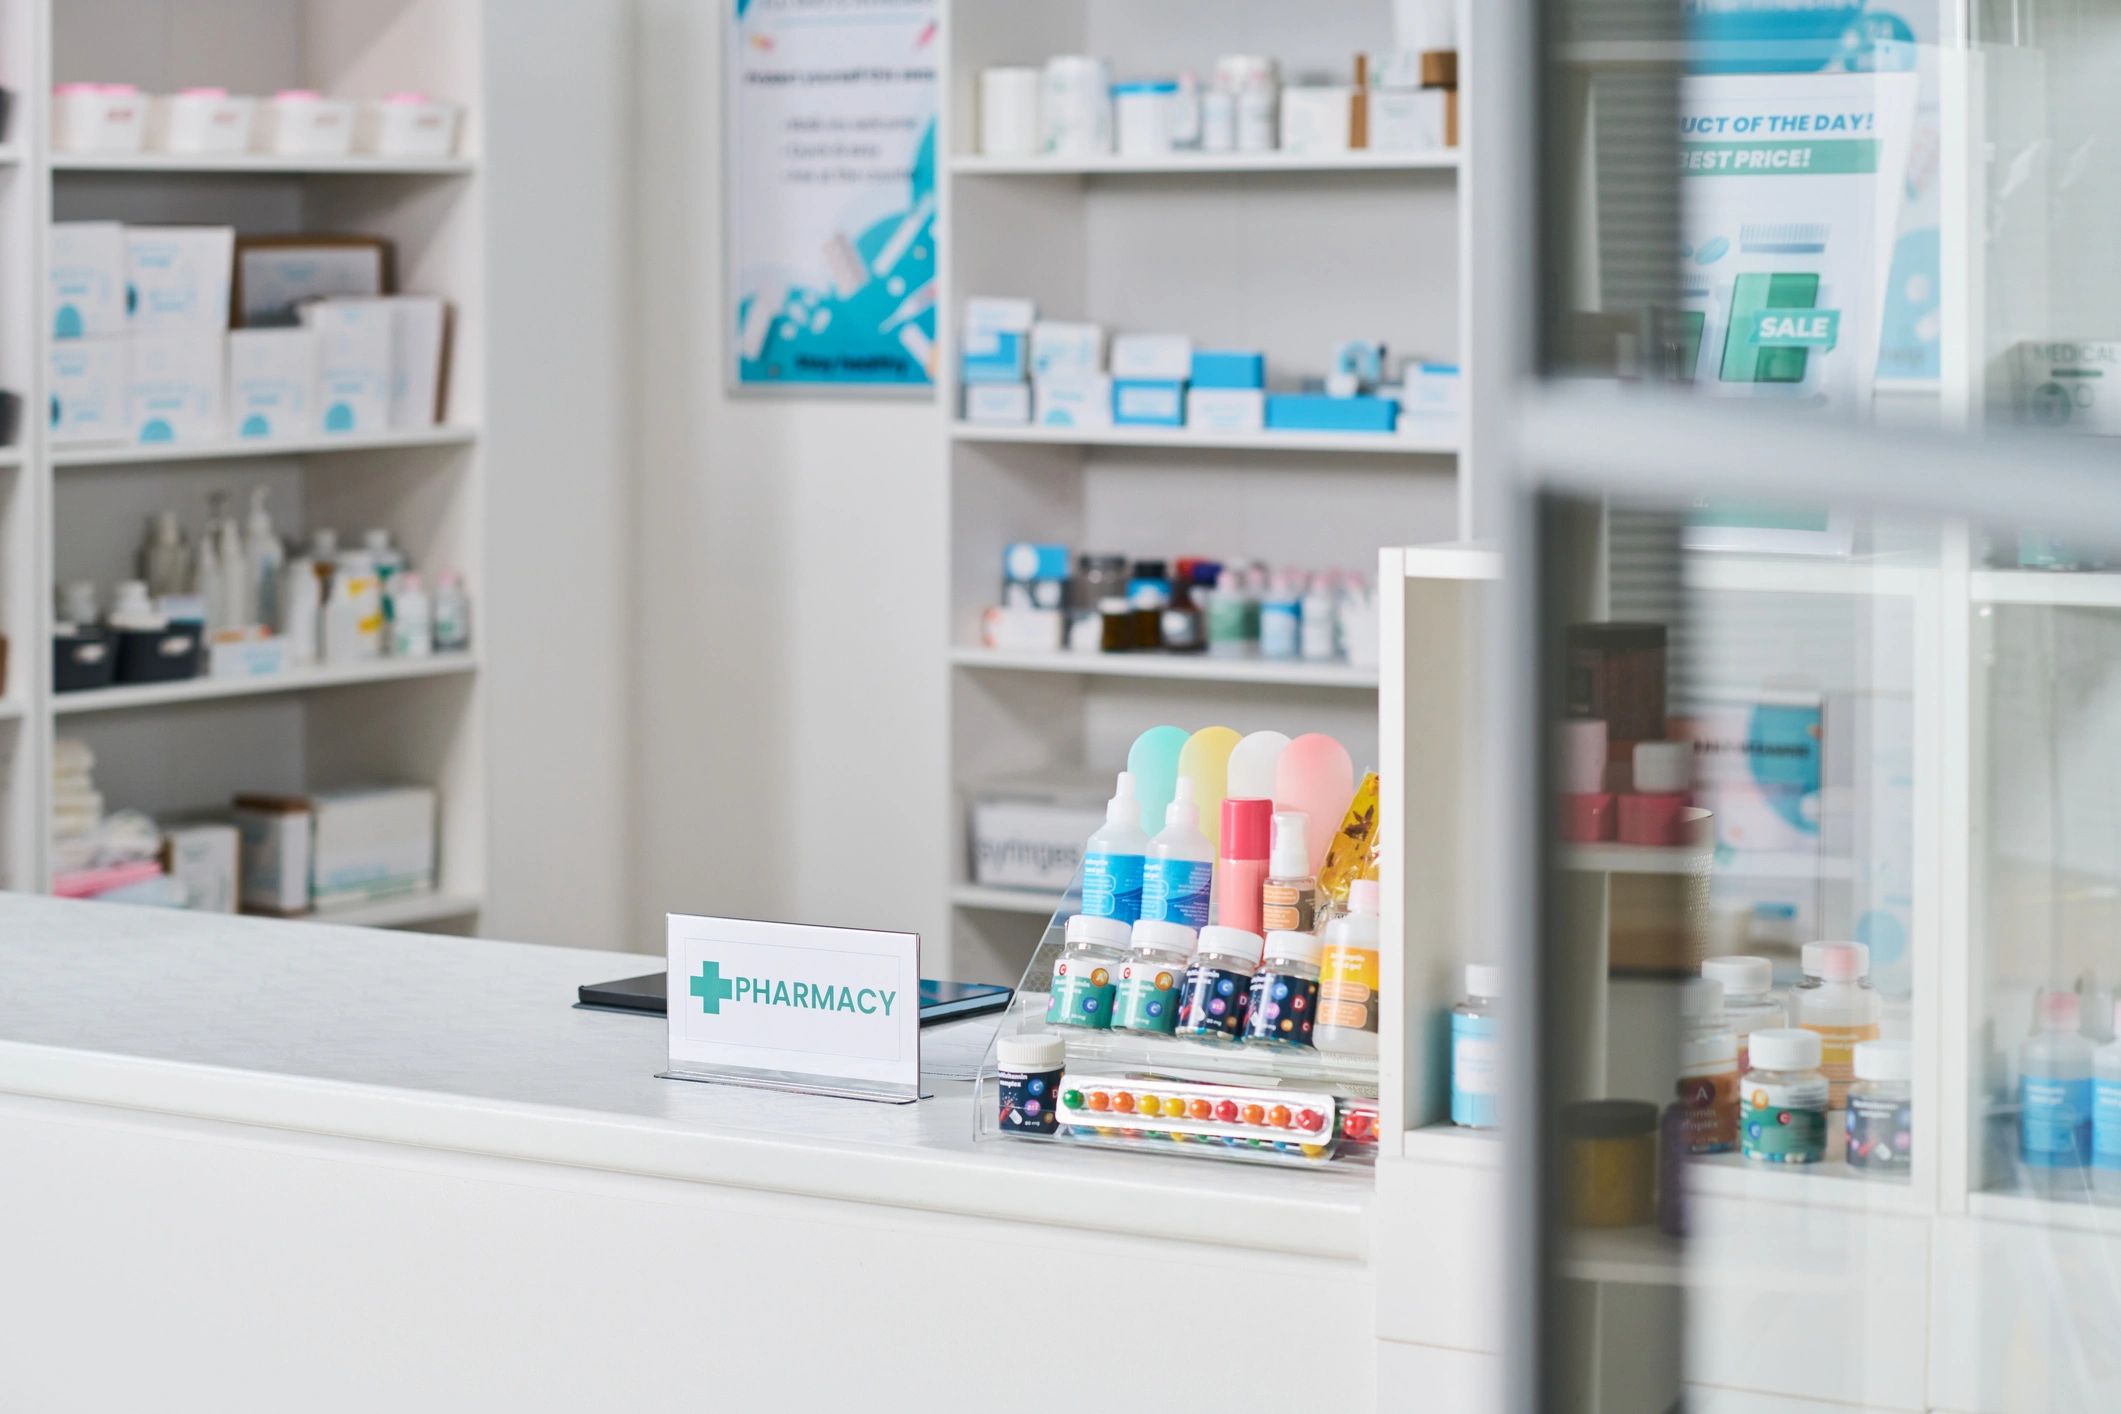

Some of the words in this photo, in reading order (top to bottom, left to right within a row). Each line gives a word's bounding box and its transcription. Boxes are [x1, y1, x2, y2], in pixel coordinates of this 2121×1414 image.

[1680, 115, 1729, 133] UCT
[1732, 115, 1764, 133] OF
[1768, 114, 1810, 132] THE
[1814, 112, 1875, 131] DAY!
[1734, 148, 1812, 169] PRICE!
[1760, 316, 1830, 338] SALE
[736, 976, 897, 1016] PHARMACY
[1696, 1086, 1708, 1100] A
